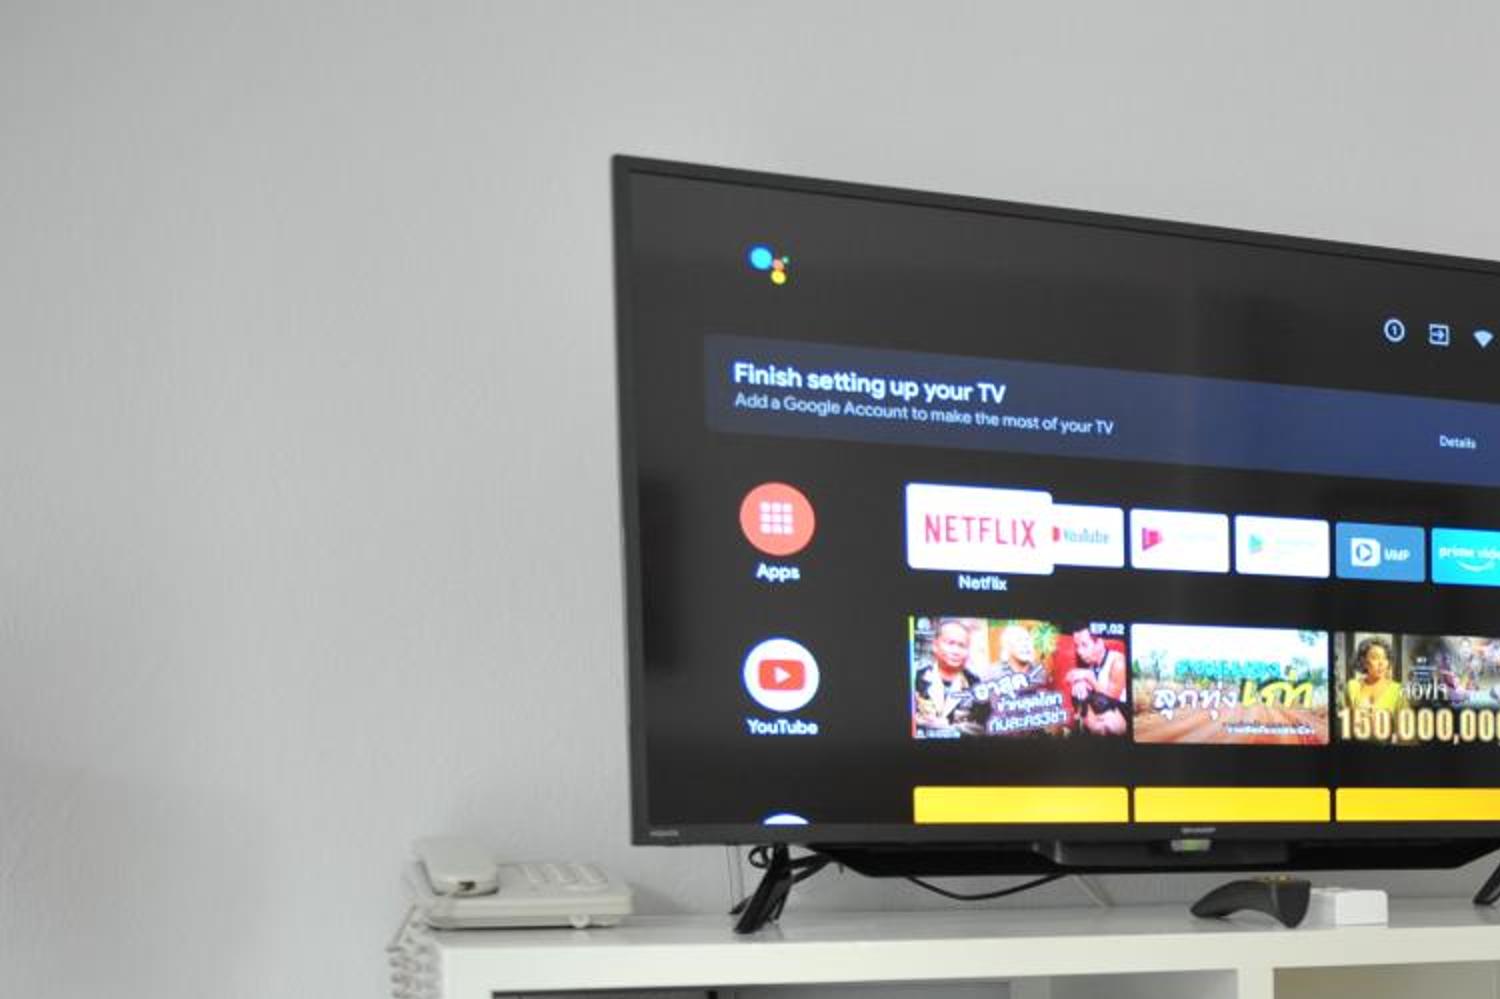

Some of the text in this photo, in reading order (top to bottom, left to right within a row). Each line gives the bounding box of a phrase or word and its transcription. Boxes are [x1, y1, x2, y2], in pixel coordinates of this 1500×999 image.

[734, 362, 1006, 404] Finish setting up your TV
[735, 392, 1114, 435] Add a Google Account to make the most of your TV
[1439, 434, 1477, 450] Details
[924, 513, 1036, 549] NETFLIX
[756, 563, 800, 582] Apps
[958, 574, 1007, 591] Netflix
[747, 719, 819, 735] YouTube
